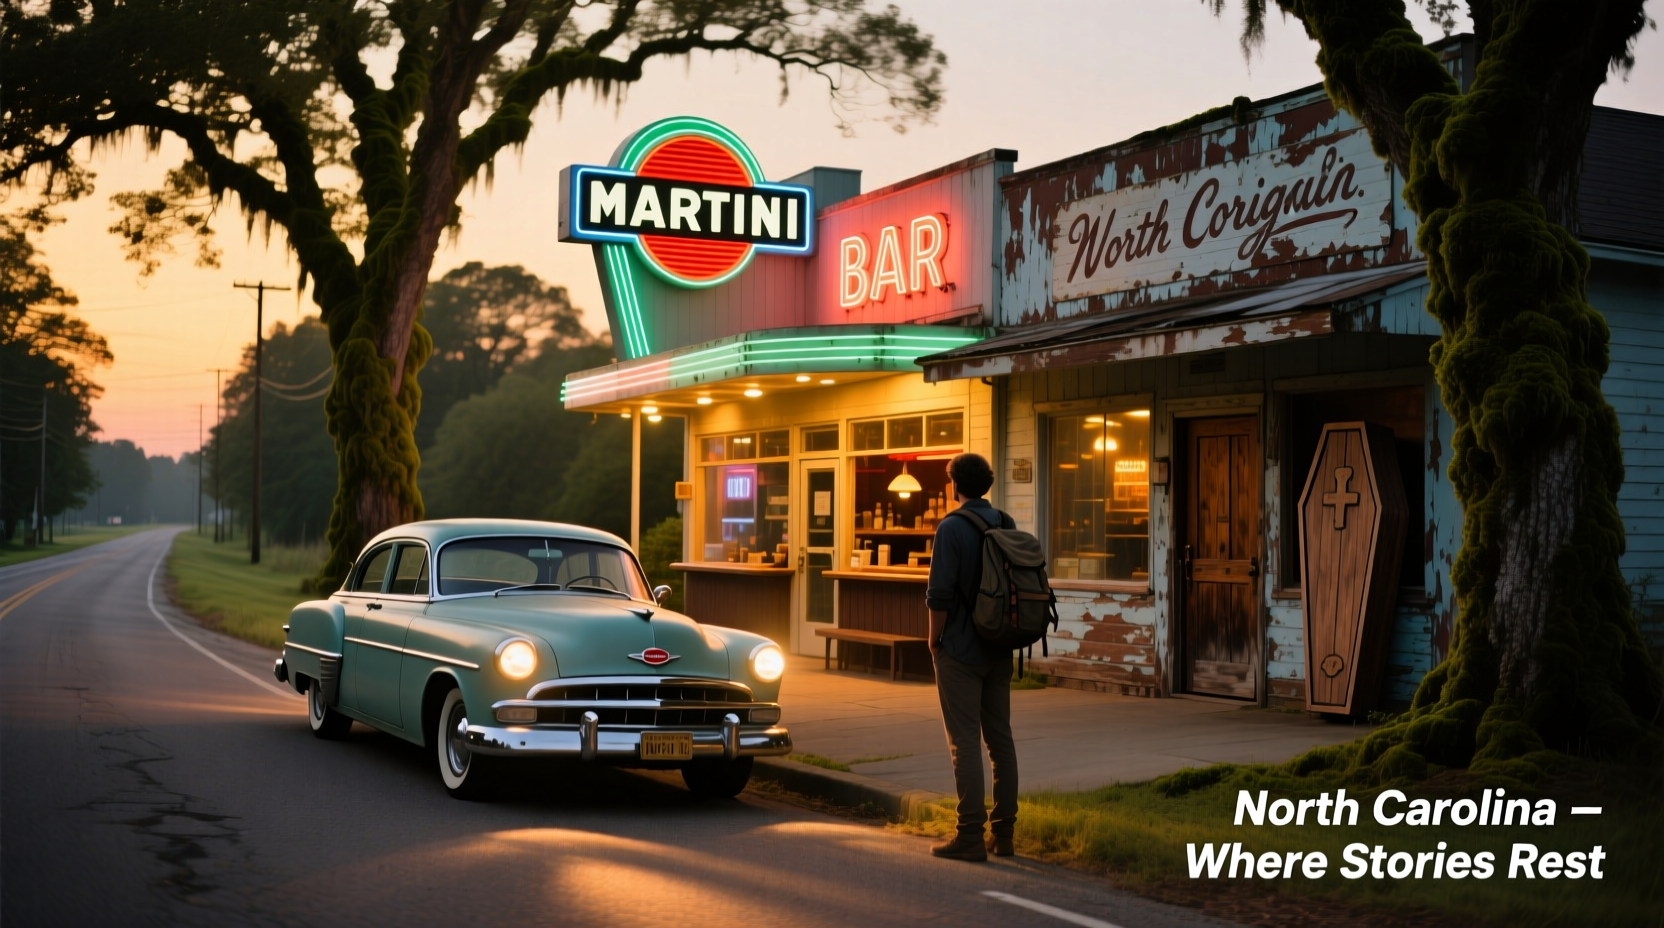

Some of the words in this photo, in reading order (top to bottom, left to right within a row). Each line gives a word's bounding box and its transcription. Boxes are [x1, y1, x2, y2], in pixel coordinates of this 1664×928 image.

[589, 180, 798, 240] MARTINI
[1067, 198, 1171, 284] Worth
[840, 214, 946, 308] BAR
